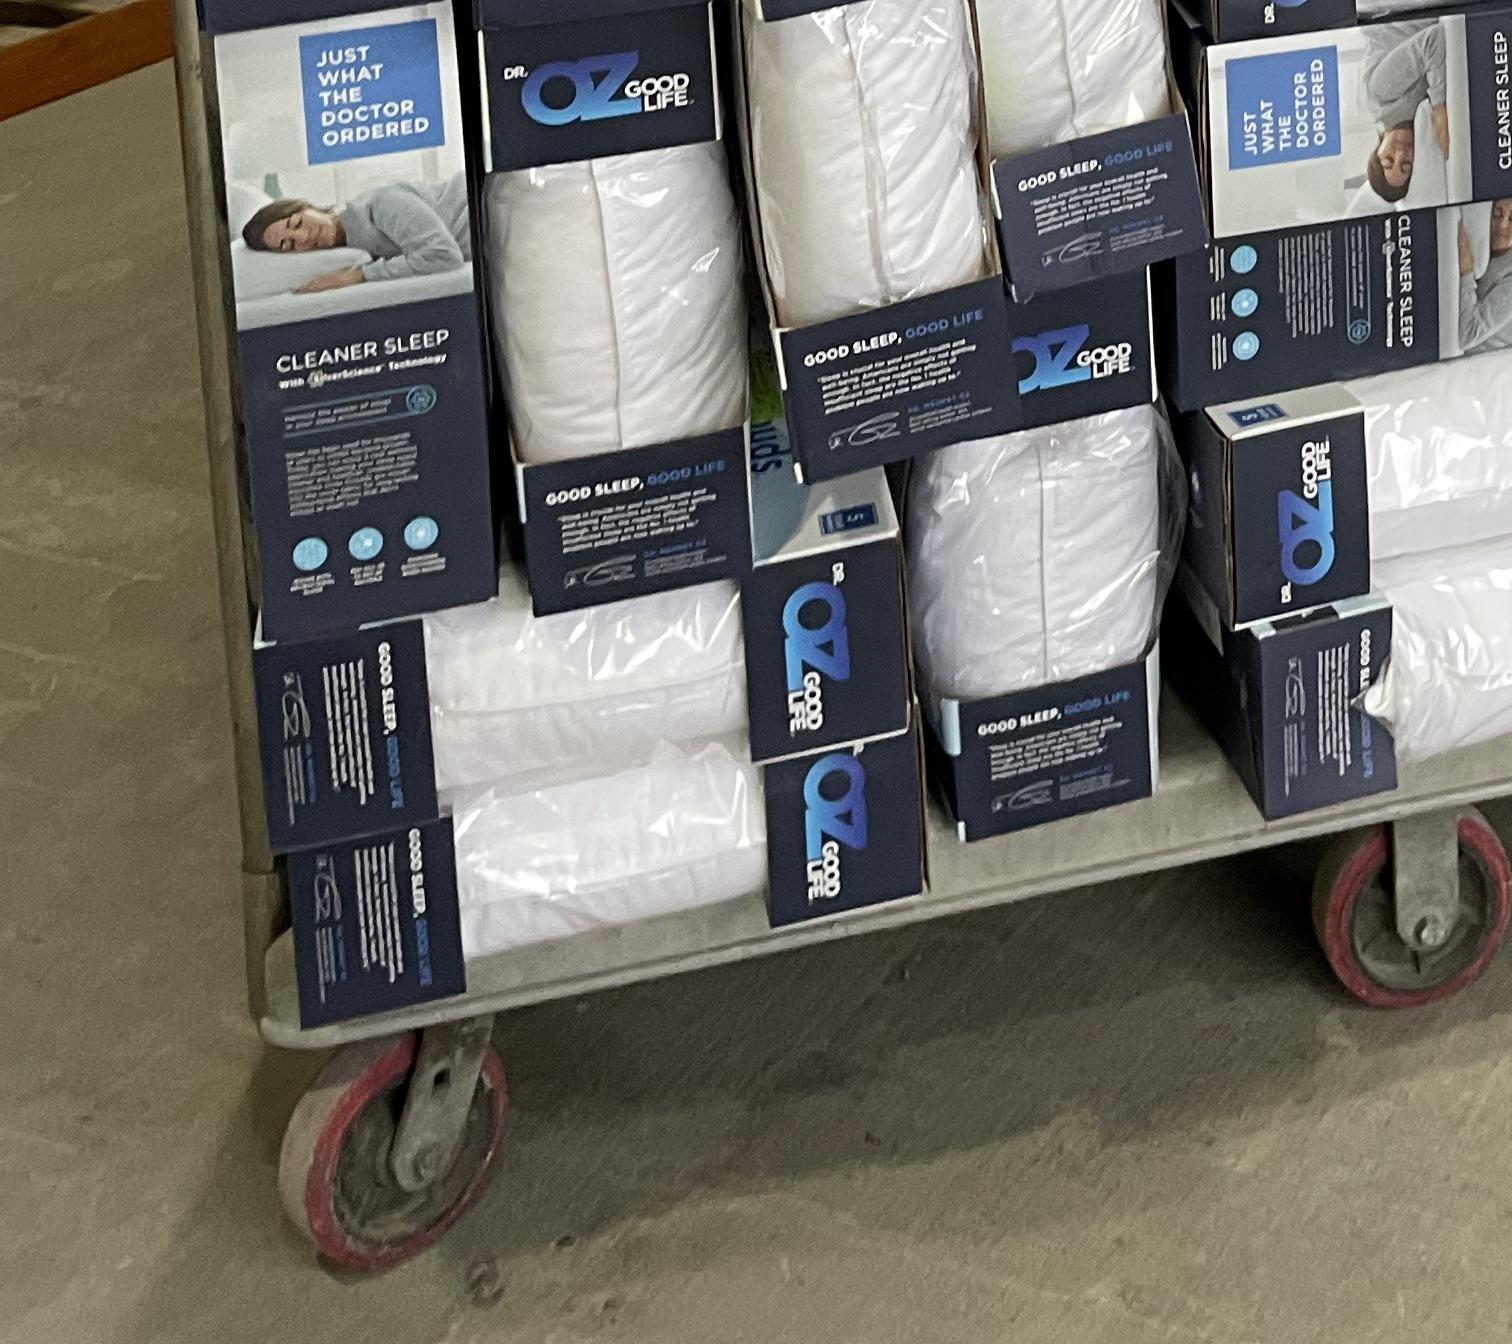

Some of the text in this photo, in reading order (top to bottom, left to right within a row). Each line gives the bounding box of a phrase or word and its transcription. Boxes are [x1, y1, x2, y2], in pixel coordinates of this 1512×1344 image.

[316, 45, 370, 68] JUST
[318, 63, 384, 87] WHAT
[318, 86, 362, 107] THE
[321, 99, 414, 127] DOCTOR
[321, 116, 430, 147] ORDERED
[1018, 171, 1057, 192] GOOD
[804, 345, 850, 367] GOOD
[782, 581, 850, 691] OZ
[787, 690, 806, 733] LIFE
[803, 671, 823, 731] GOOD
